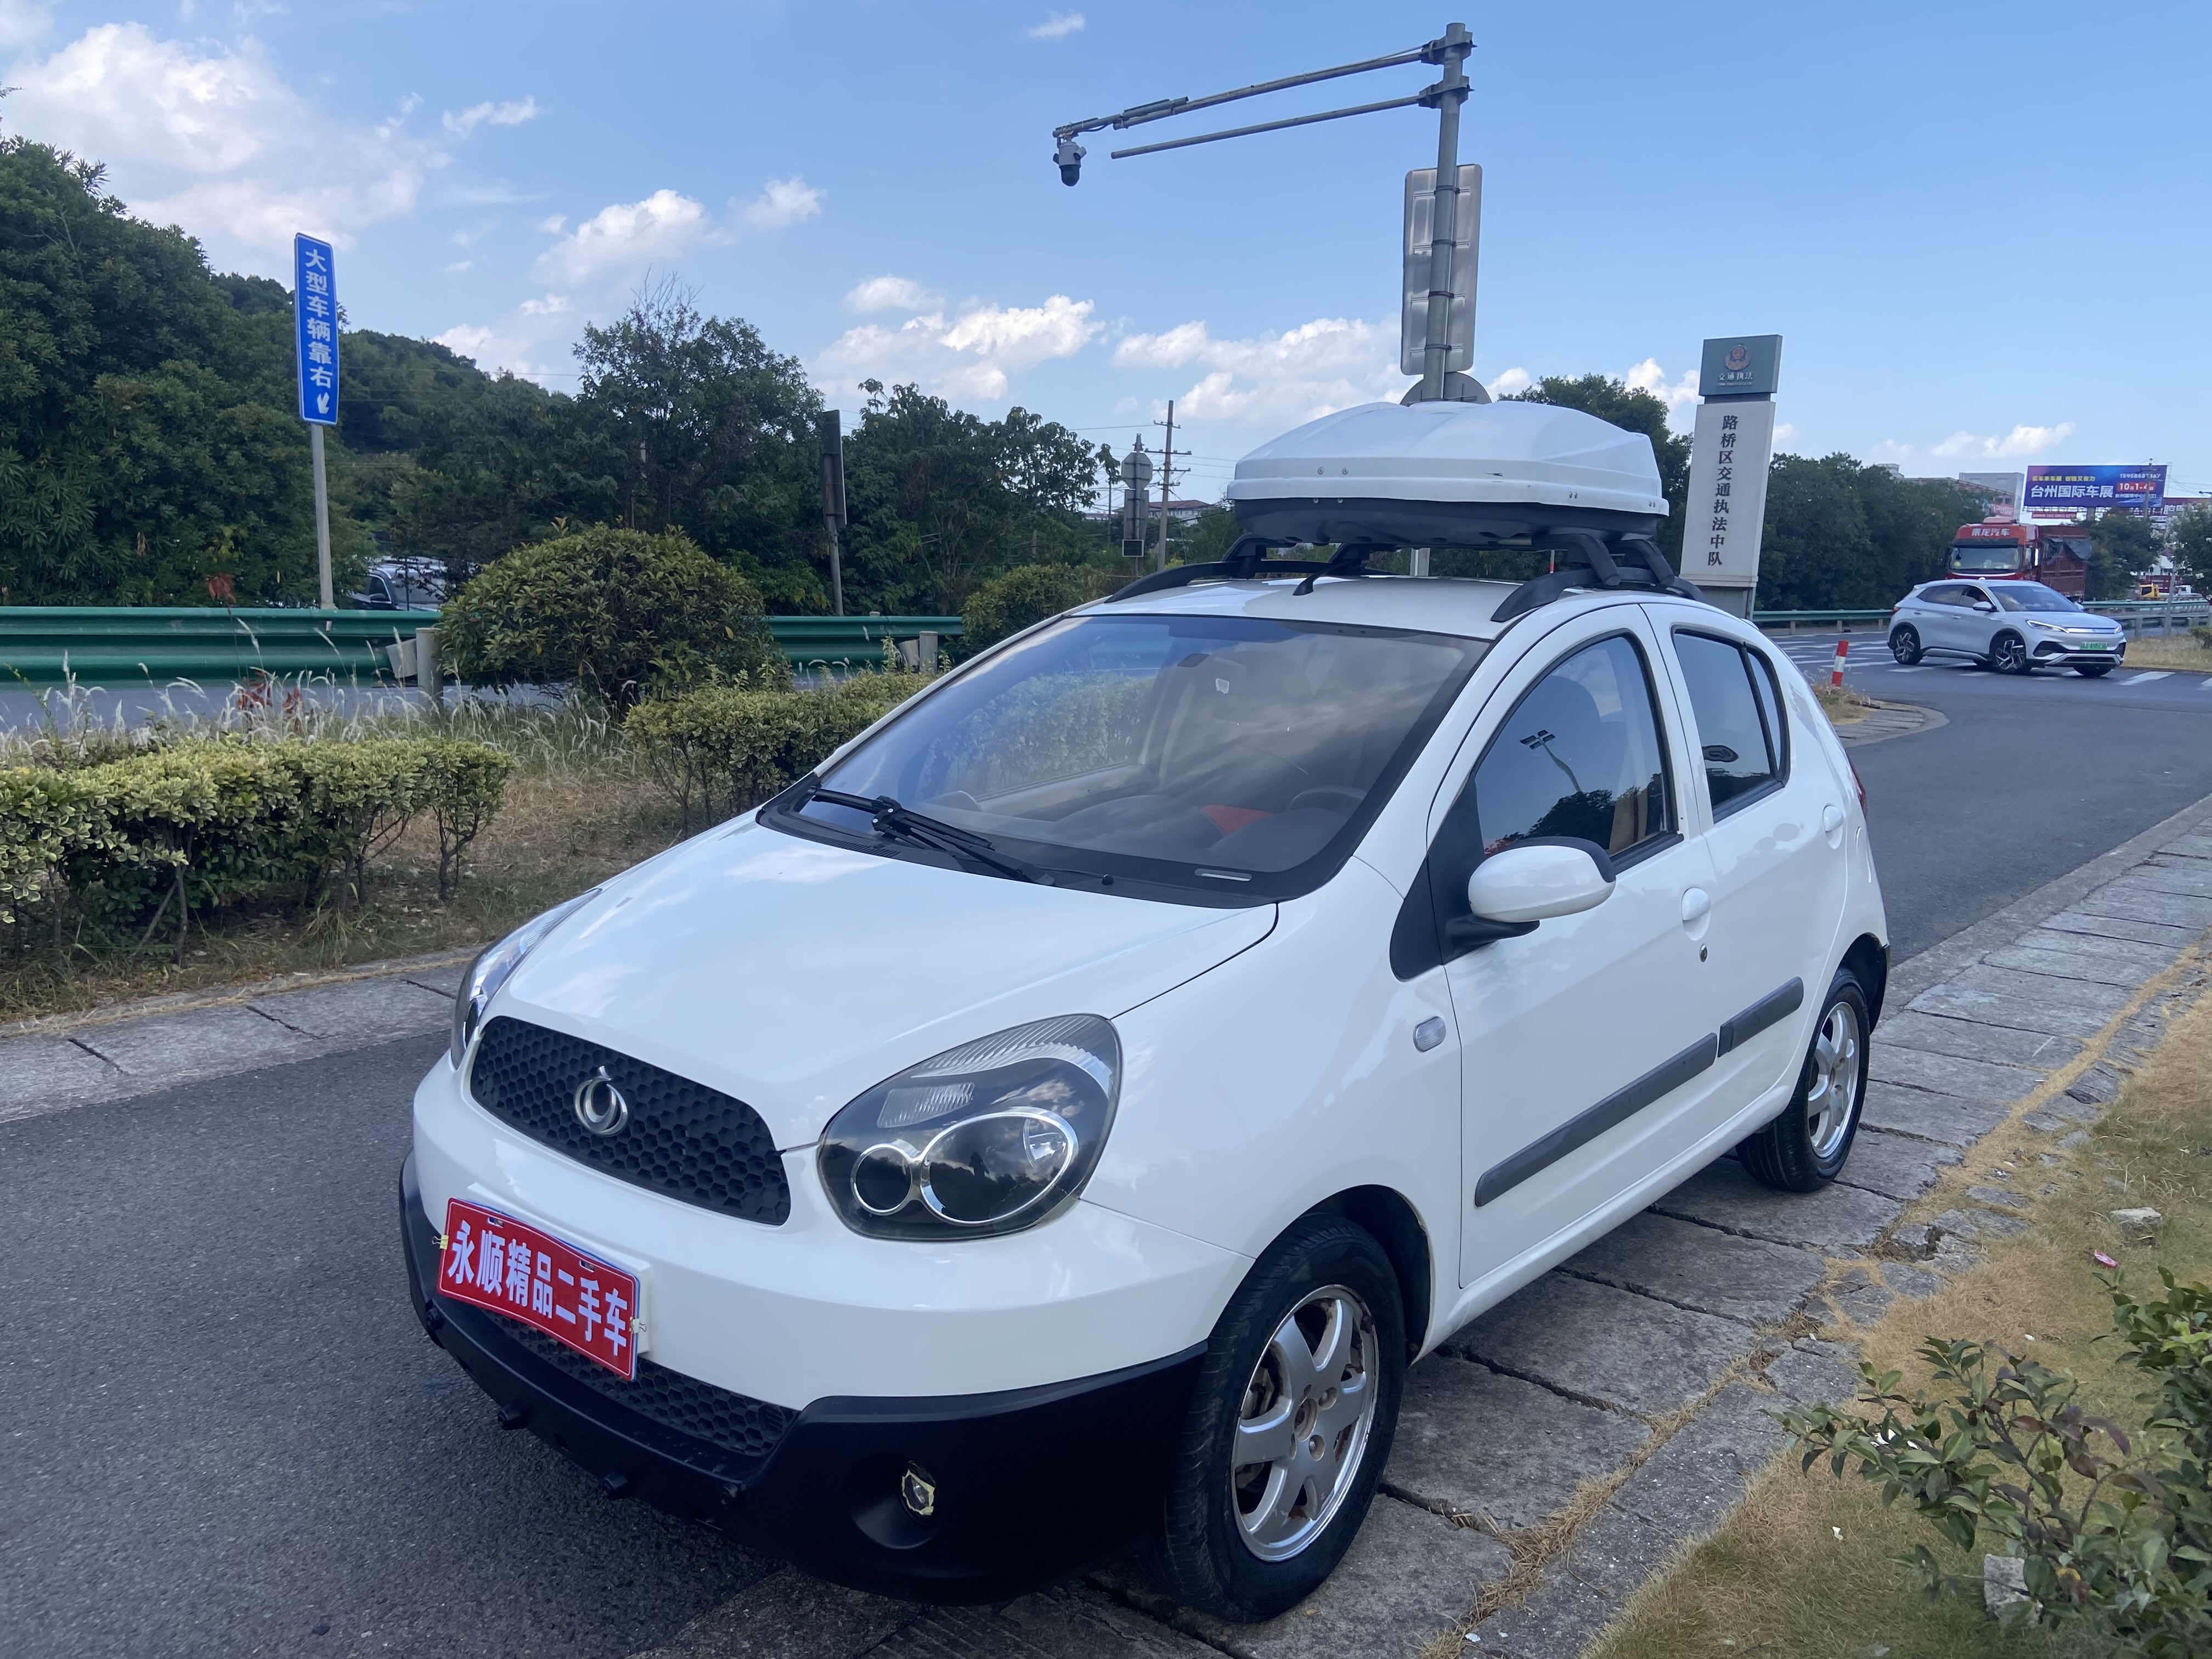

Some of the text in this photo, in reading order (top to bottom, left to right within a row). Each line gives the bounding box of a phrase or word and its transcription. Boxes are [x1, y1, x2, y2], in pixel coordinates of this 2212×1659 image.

[305, 249, 332, 388] 大型车辆靠右
[1718, 372, 1753, 381] 交通执法
[1707, 415, 1739, 566] 路桥区交通执法中队
[2031, 485, 2114, 498] 台州国际车展
[448, 1220, 628, 1357] 永顺精品二手车
